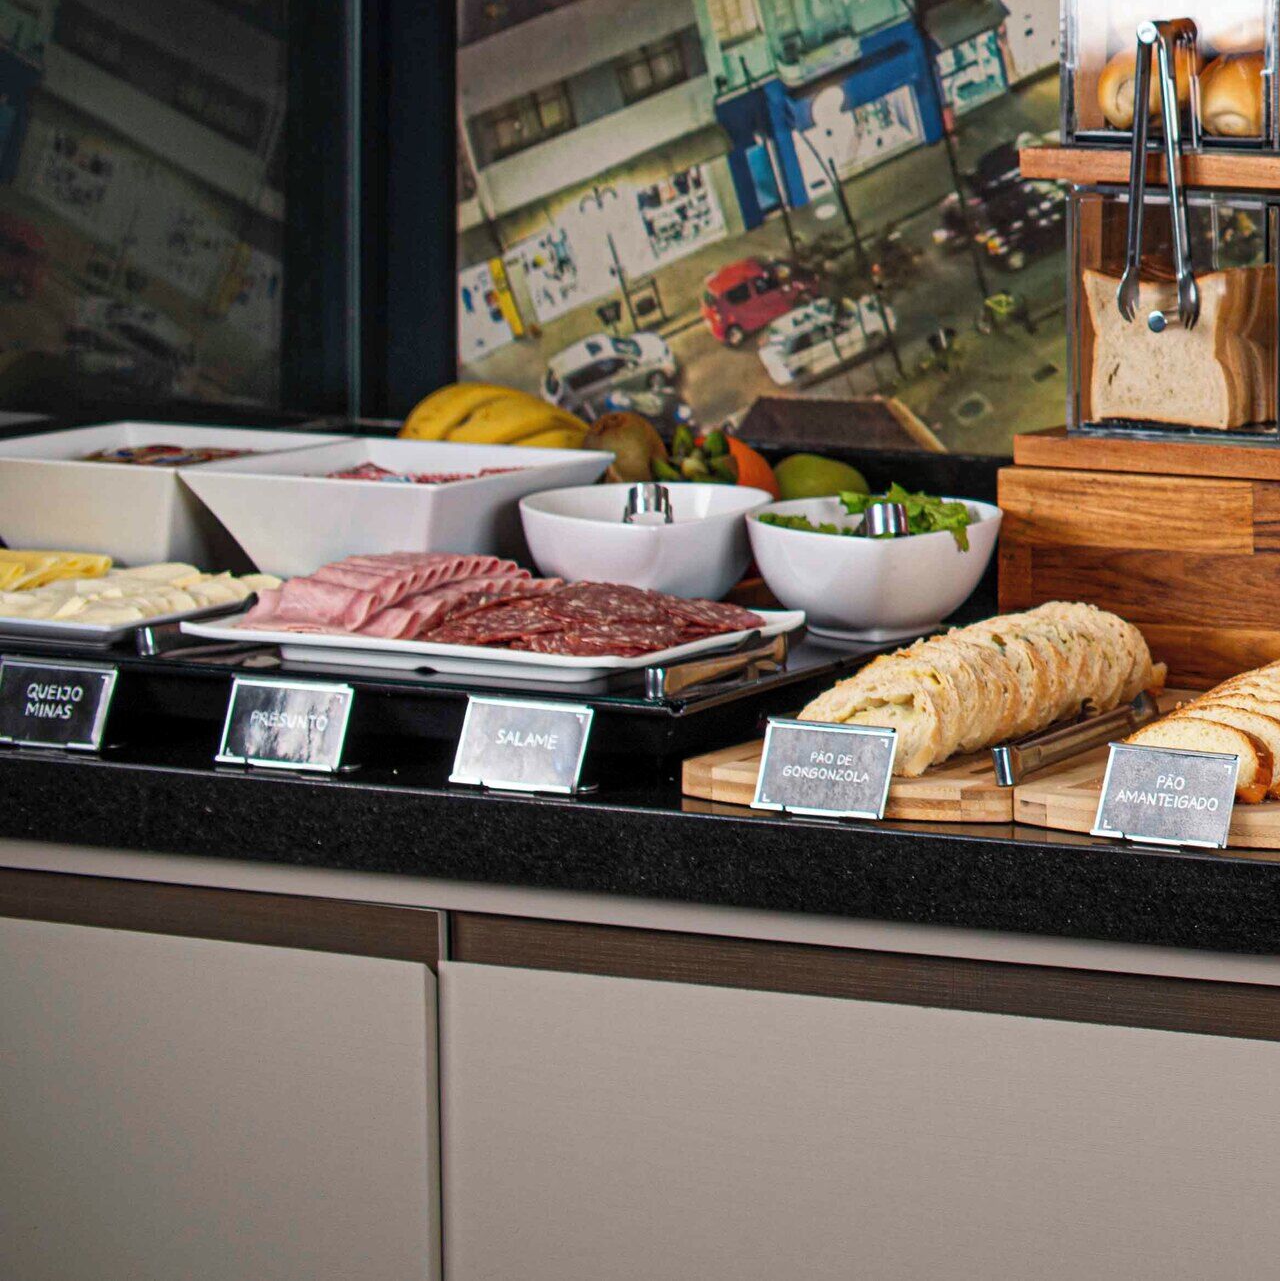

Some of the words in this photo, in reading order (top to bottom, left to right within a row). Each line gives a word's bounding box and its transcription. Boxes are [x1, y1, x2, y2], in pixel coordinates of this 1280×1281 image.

[26, 682, 83, 702] QUEIJO
[25, 702, 73, 719] MINAS
[250, 709, 328, 732] PRESUNTO
[495, 729, 559, 750] SALAME
[810, 750, 834, 764] PÃO
[837, 755, 853, 765] DE
[782, 765, 869, 782] GORGONZOLA
[1156, 773, 1185, 790] PÃO
[1115, 789, 1219, 811] AMANTEIGADO
